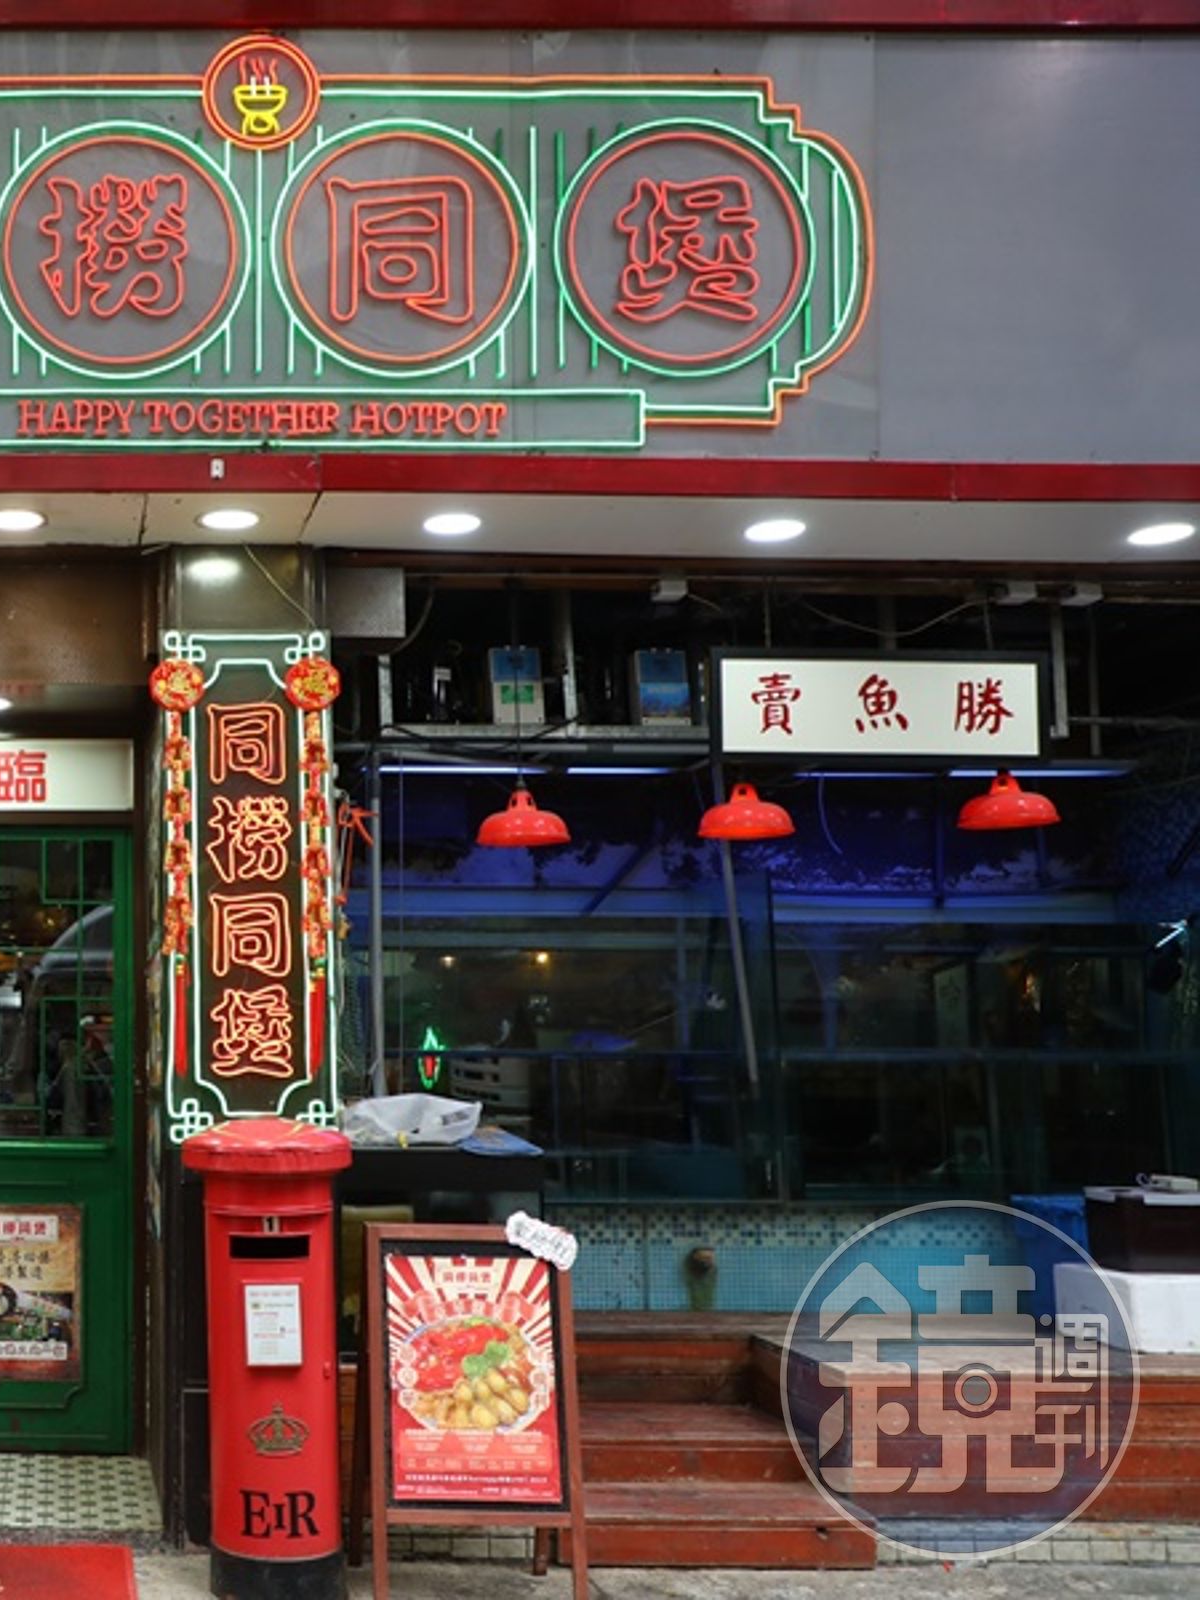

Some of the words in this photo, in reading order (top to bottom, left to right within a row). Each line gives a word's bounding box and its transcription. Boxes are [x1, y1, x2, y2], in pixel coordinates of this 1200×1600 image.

[17, 399, 135, 437] HAPPY
[142, 399, 342, 437] TOGETHER
[348, 401, 508, 437] HOTPOT
[751, 672, 1013, 734] 賣魚勝
[205, 702, 294, 1077] 同撈同煲
